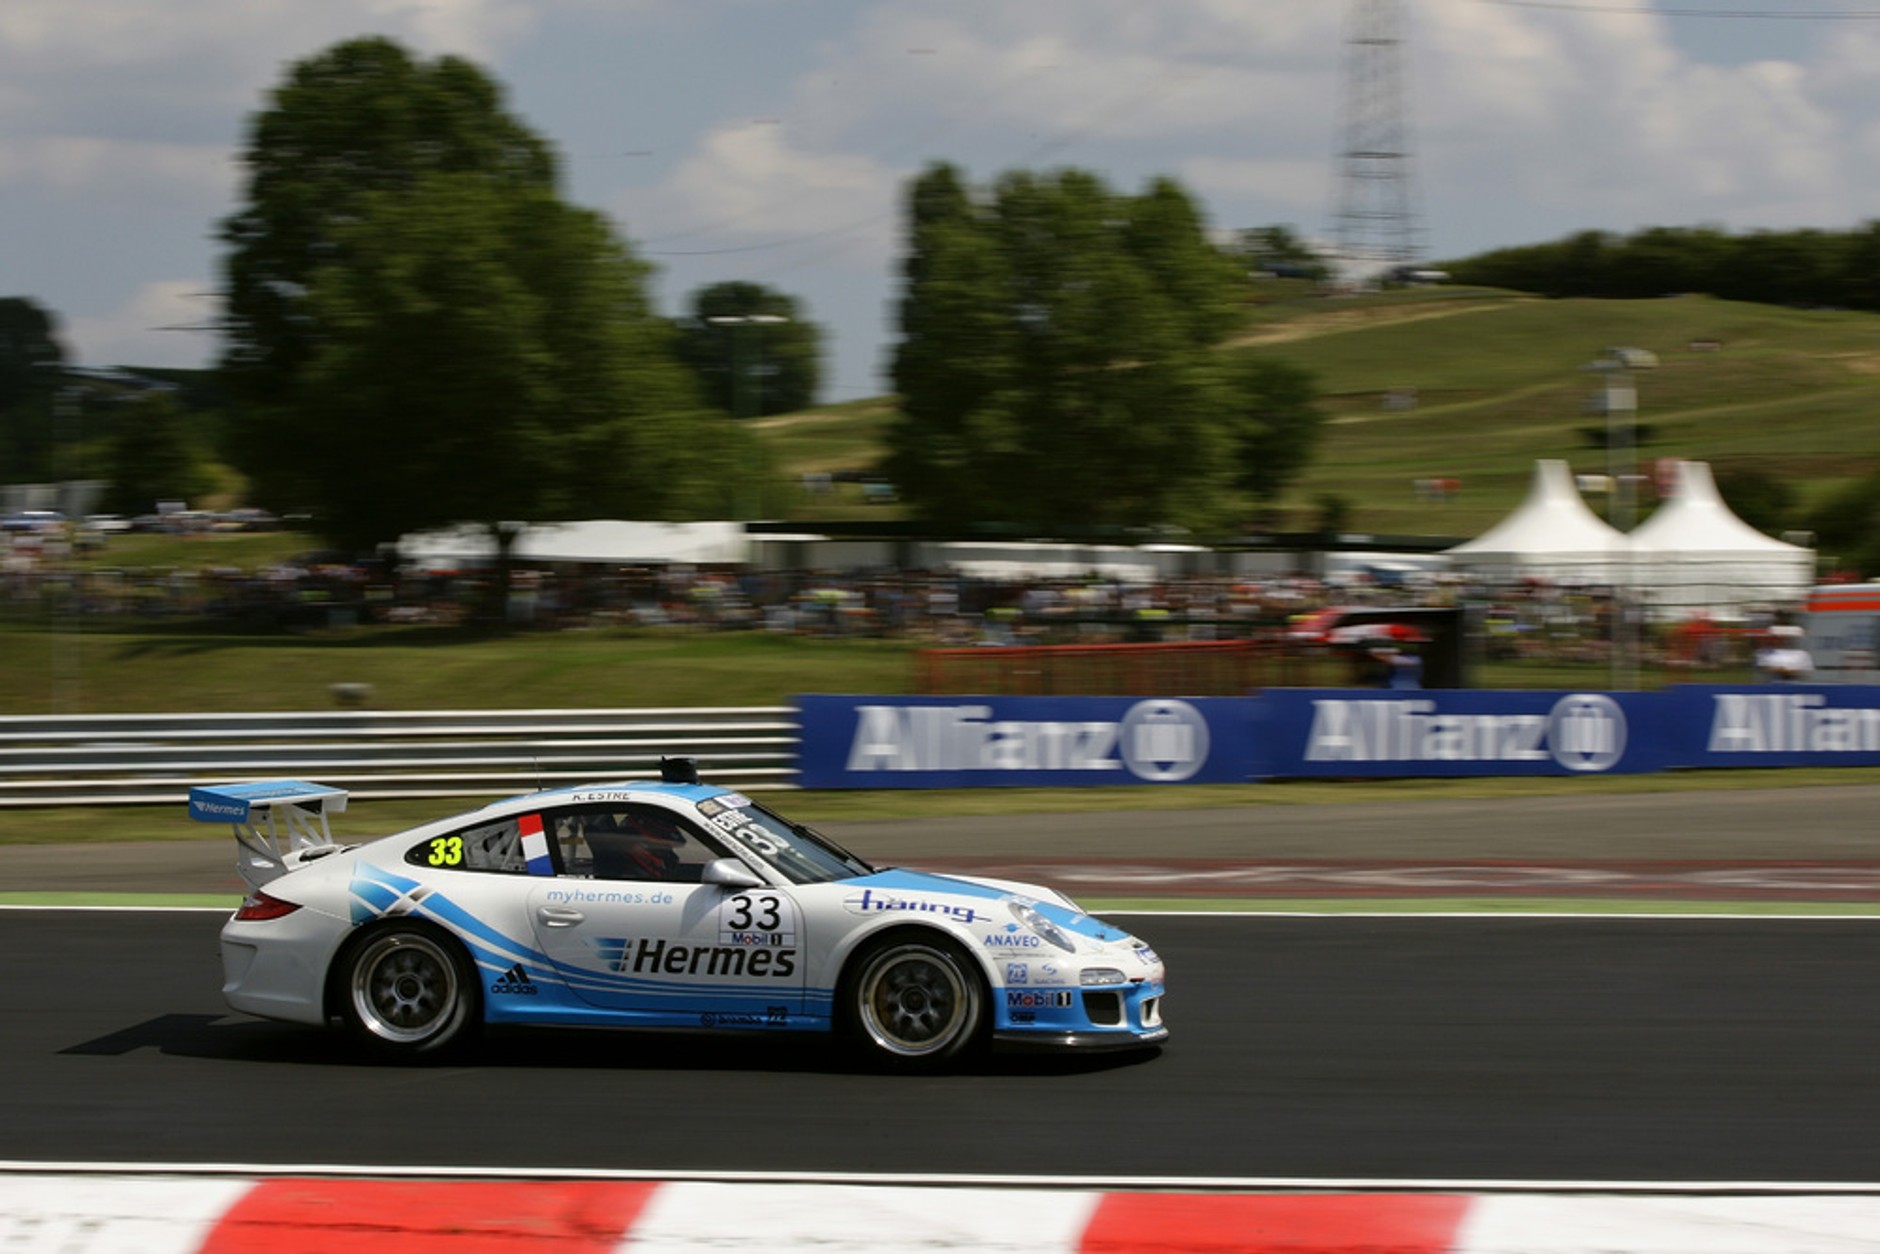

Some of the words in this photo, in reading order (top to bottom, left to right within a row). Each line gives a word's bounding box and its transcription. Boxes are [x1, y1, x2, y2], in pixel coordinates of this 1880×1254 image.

[845, 704, 1124, 772] Allianz
[1303, 699, 1550, 761] Allianz
[205, 802, 246, 816] Hermes
[428, 836, 463, 866] 33
[546, 888, 673, 904] myhermes.de
[727, 894, 782, 931] 33
[732, 932, 768, 946] Mobil
[770, 933, 783, 946] 1
[984, 934, 1041, 948] ANAVEO
[632, 938, 797, 978] Hermes
[490, 983, 539, 996] adidas
[1007, 991, 1055, 1008] Mobil
[1056, 991, 1072, 1007] 1
